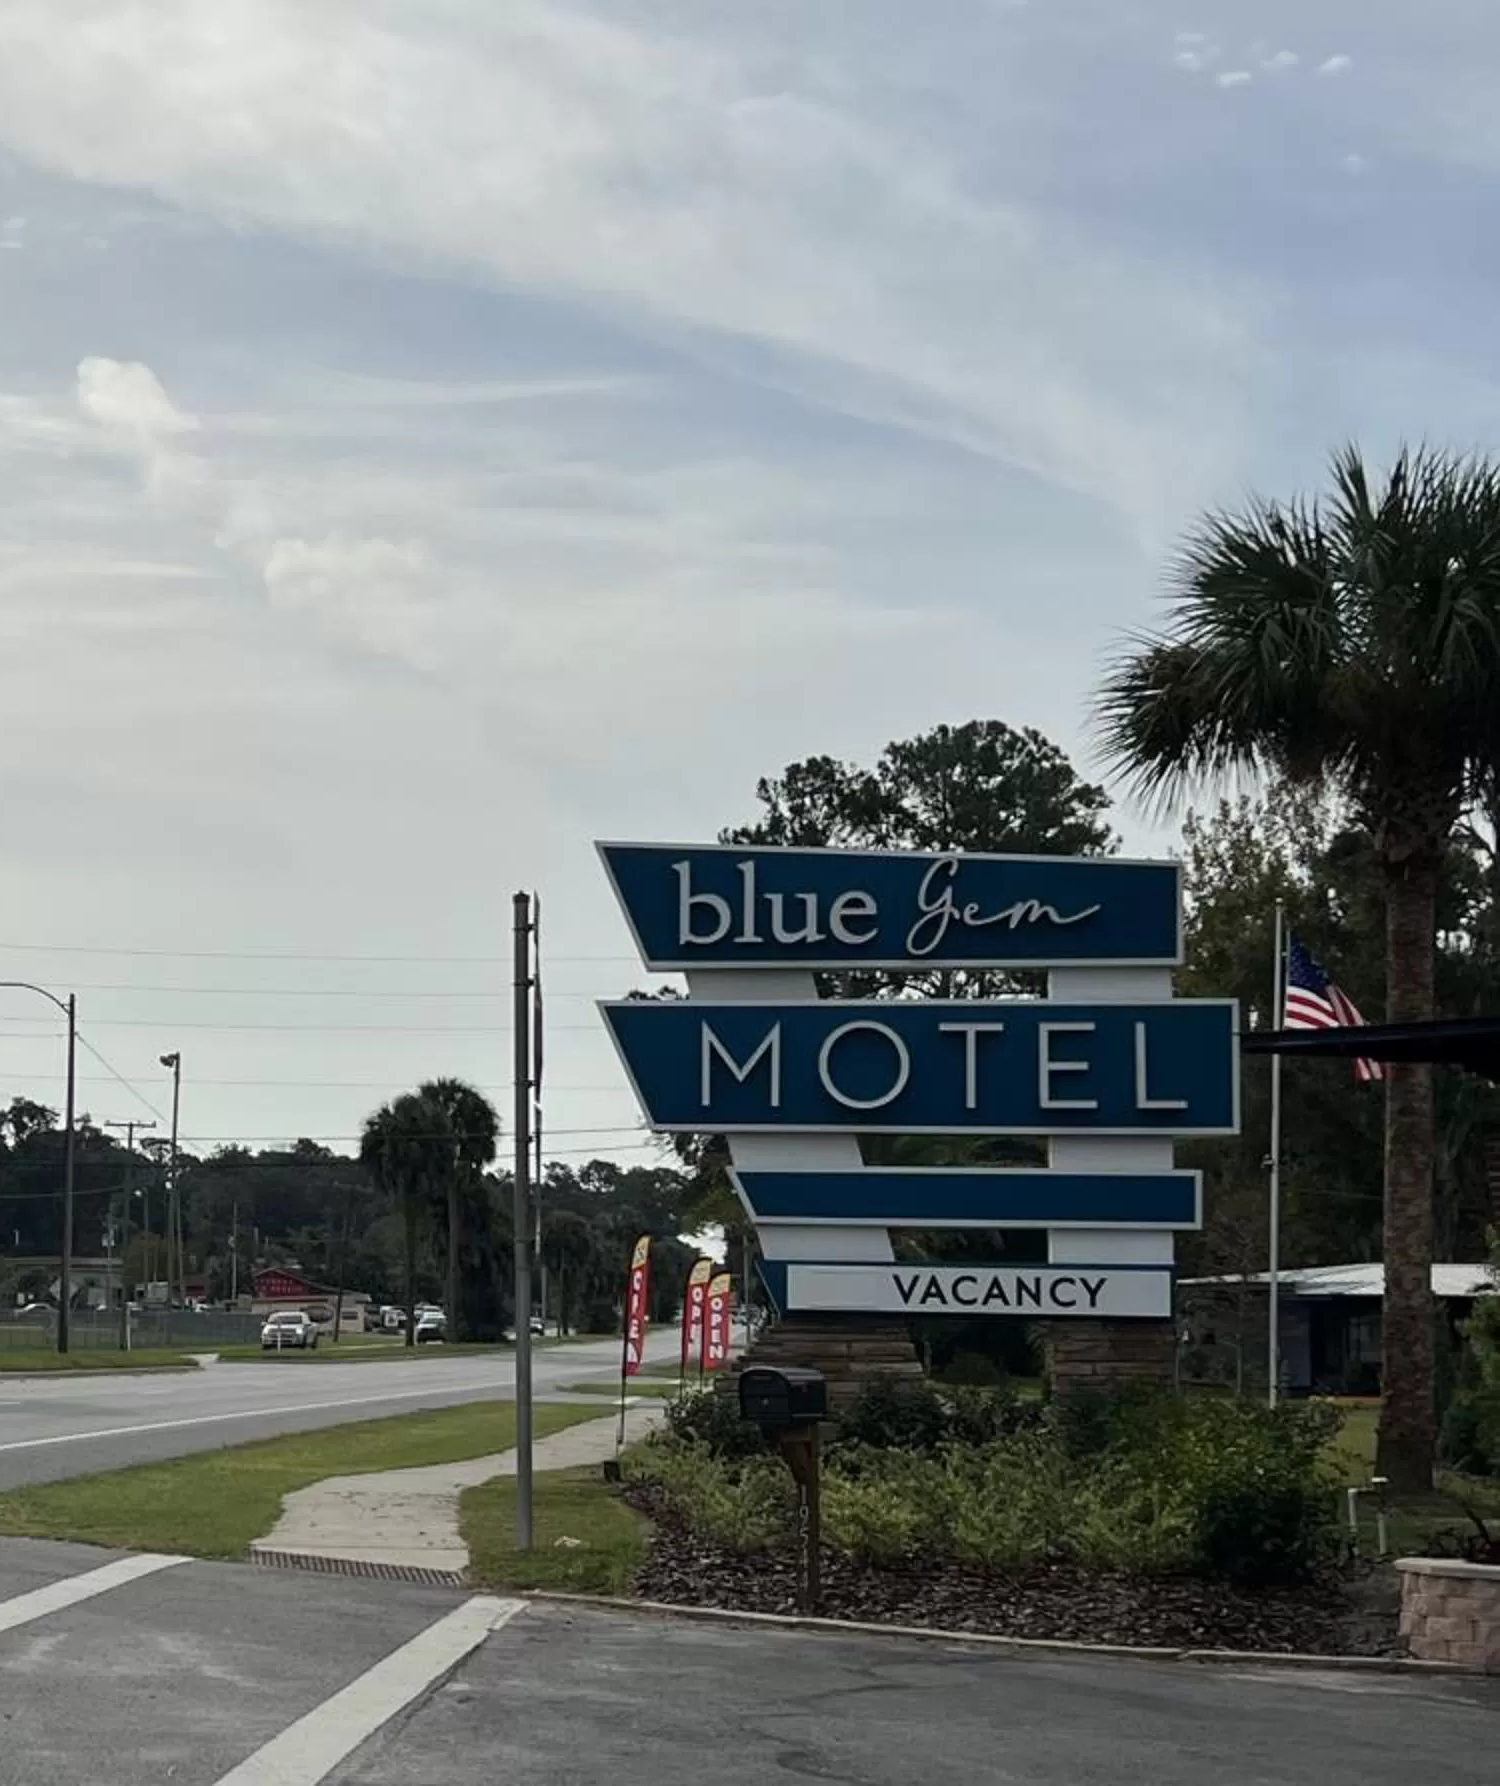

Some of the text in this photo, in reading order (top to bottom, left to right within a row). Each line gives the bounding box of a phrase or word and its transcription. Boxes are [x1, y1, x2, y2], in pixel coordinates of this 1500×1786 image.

[672, 857, 1101, 955] blue Gem
[701, 1020, 1189, 1110] MOTEL
[627, 1269, 643, 1363] OE
[688, 1286, 703, 1354] OP
[708, 1297, 723, 1359] OPEN
[892, 1273, 1108, 1308] VACANCY
